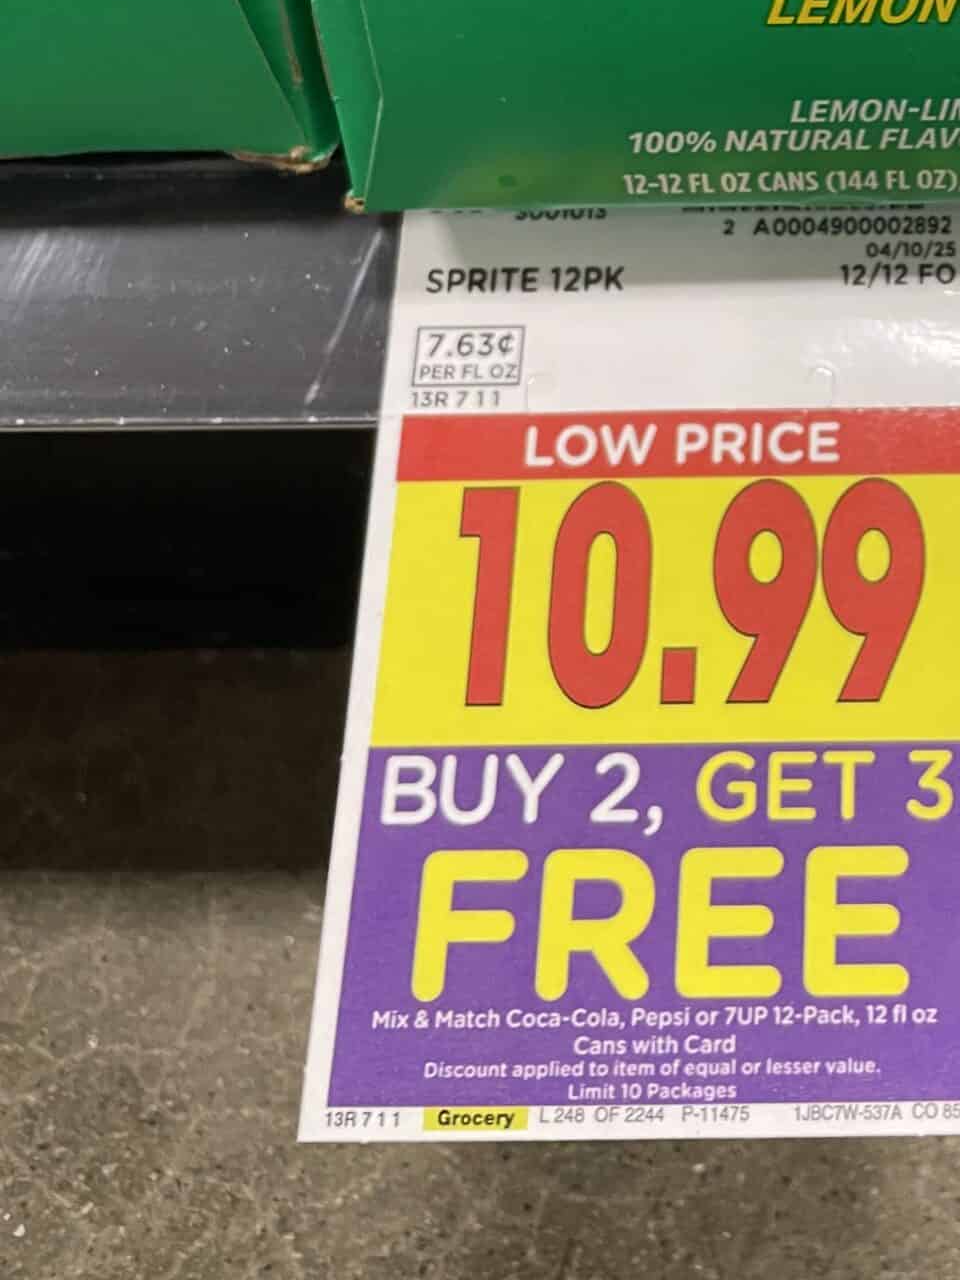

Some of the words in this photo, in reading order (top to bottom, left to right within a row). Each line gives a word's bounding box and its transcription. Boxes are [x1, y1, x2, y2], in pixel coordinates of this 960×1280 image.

[629, 131, 717, 153] 100%
[724, 128, 871, 152] NATURAL
[623, 173, 684, 195] 12-12
[688, 173, 715, 193] FL
[720, 172, 752, 193] OZ
[757, 170, 818, 192] CANS
[825, 169, 878, 194] (144
[886, 169, 911, 190] FL
[722, 219, 735, 236] 2
[753, 215, 953, 237] A0004900002892
[865, 241, 957, 260] 04/10/25
[425, 267, 540, 294] SPRITE
[551, 266, 625, 292] 12PK
[840, 263, 908, 288] 12/12
[919, 263, 957, 285] FO
[427, 332, 514, 357] 7.63¢
[419, 364, 456, 380] PER
[461, 363, 483, 379] FL
[489, 363, 519, 379] OZ
[410, 391, 448, 408] 13R
[523, 424, 657, 467] LOW
[675, 422, 840, 464] PRICE
[459, 477, 927, 709] 10.99
[380, 752, 565, 825] BUY
[590, 752, 663, 836] 2,
[695, 750, 876, 822] GET
[906, 750, 954, 821] 3
[411, 846, 910, 1002] FREE
[371, 1011, 408, 1029] Mix
[413, 1011, 429, 1028] &
[434, 1010, 499, 1028] Match
[506, 1008, 625, 1031] Coca-Cola,
[631, 1007, 689, 1029] Pepsi
[695, 1011, 718, 1025] or
[724, 1006, 767, 1025] 7UP
[774, 1005, 860, 1027] 12-Pack,
[866, 1006, 886, 1023] 12
[892, 1004, 906, 1022] fl
[911, 1008, 937, 1024] oz
[573, 1036, 626, 1055] Cans
[631, 1035, 678, 1054] with
[684, 1034, 736, 1054] Card
[424, 1061, 507, 1079] Discount
[512, 1060, 583, 1081] applied
[589, 1062, 608, 1077] to
[613, 1060, 655, 1077] item
[660, 1059, 681, 1076] of
[685, 1058, 736, 1079] equal
[741, 1061, 761, 1075] or
[766, 1058, 819, 1074] lesser
[825, 1058, 881, 1074] value.
[568, 1083, 614, 1101] Limit
[621, 1083, 641, 1100] 10
[647, 1081, 737, 1102] Packages
[325, 1111, 356, 1127] 13R
[437, 1110, 514, 1129] Grocery
[594, 1107, 619, 1123] OF
[624, 1106, 664, 1123] 2244
[681, 1106, 750, 1122] P-11475
[911, 1104, 938, 1120] CO
